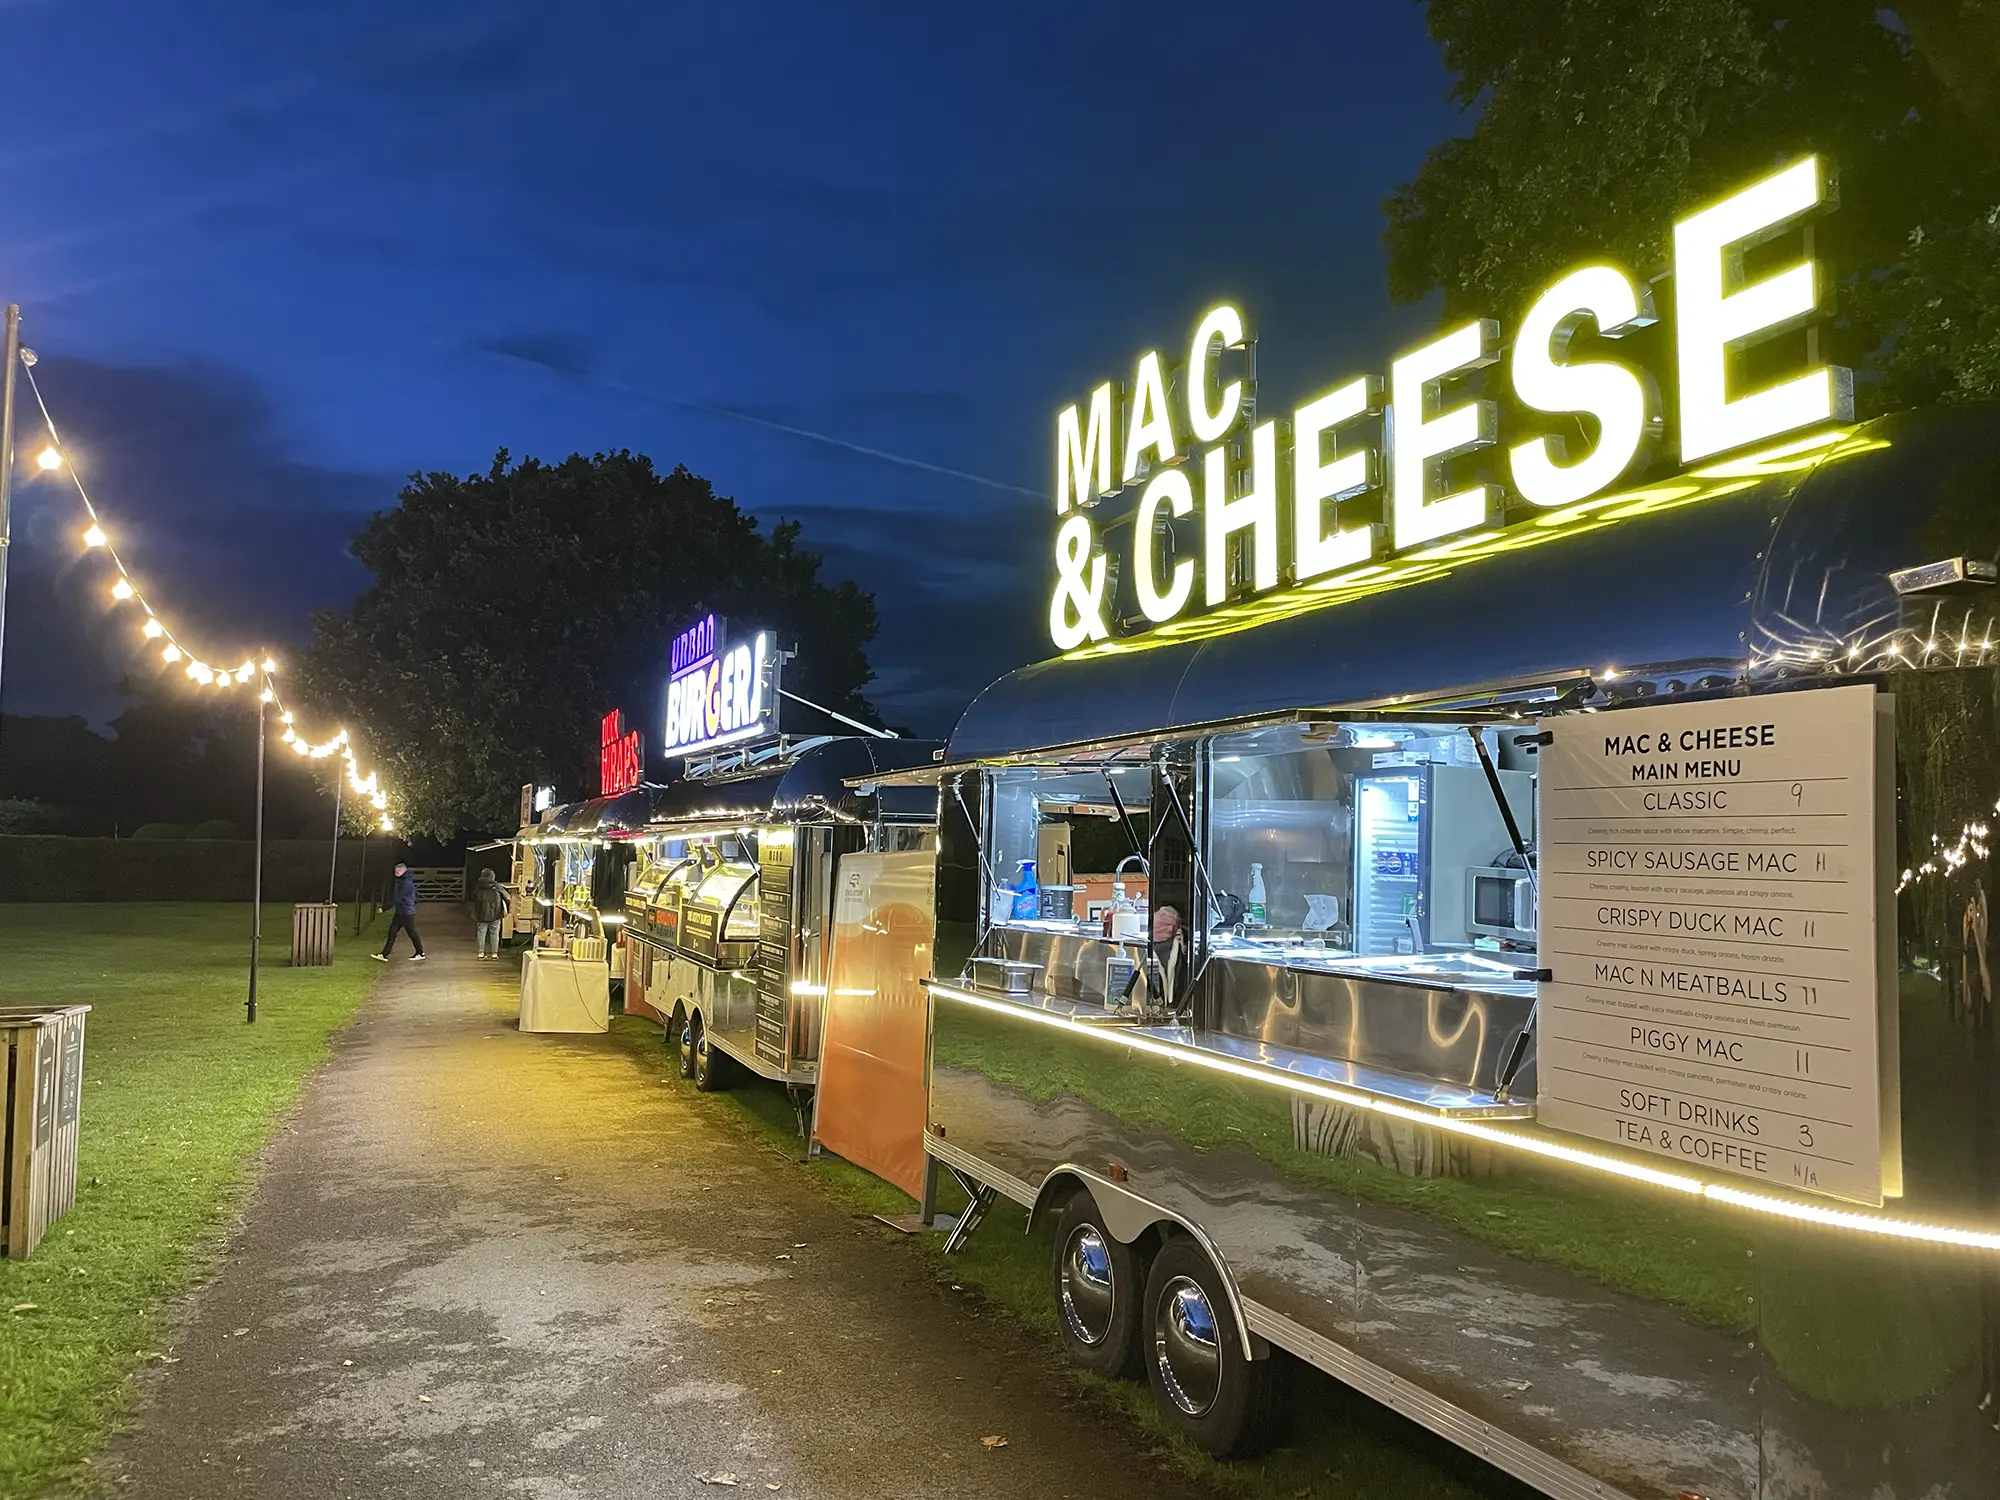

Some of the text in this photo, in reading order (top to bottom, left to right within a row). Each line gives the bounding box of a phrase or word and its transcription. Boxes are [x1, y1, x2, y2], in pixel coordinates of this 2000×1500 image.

[1049, 155, 1834, 650] & CHEESE
[1057, 306, 1245, 515] MAC
[671, 613, 714, 673] URBAN
[1605, 724, 1775, 756] MAC & CHEESE
[601, 730, 639, 795] WRAPS
[1632, 760, 1741, 781] MAIN MENU
[1643, 791, 1728, 811] CLASSIC
[1790, 783, 1803, 807] 9
[1770, 827, 1796, 835] perfect.
[1587, 851, 1798, 873] SPICY SAUSAGE MAC
[1664, 887, 1678, 895] spicy
[1749, 891, 1769, 899] crispy
[1598, 907, 1783, 937] CRISPY DUCK MAC
[1804, 920, 1815, 938] 11
[1597, 940, 1616, 948] Creamy
[1630, 943, 1648, 951] loaded
[1662, 947, 1680, 955] crispy
[1681, 948, 1696, 956] duck,
[1698, 950, 1717, 958] spring
[1718, 951, 1740, 959] onions,
[1595, 964, 1788, 1003] MAC N MEATBALLS
[1586, 996, 1605, 1005] Creamy
[1618, 1001, 1637, 1009] topped
[1666, 1008, 1693, 1017] meatballs
[1694, 1011, 1713, 1020] crispy
[1714, 1015, 1735, 1023] onions
[1749, 1019, 1766, 1027] fresh
[1630, 1027, 1744, 1062] PIGGY MAC
[1796, 1050, 1809, 1074] 11
[1635, 1062, 1653, 1071] loaded
[1655, 1066, 1667, 1074] with
[1668, 1069, 1686, 1078] crispy
[1687, 1072, 1715, 1084] pancetta,
[1716, 1078, 1747, 1088] parmesan
[1748, 1083, 1760, 1091] and
[1762, 1086, 1782, 1095] crispy
[1620, 1088, 1760, 1136] SOFT DRINKS
[1615, 1118, 1768, 1173] TEA & COFFEE
[1798, 1124, 1814, 1148] 3
[1793, 1164, 1819, 1187] N/A
